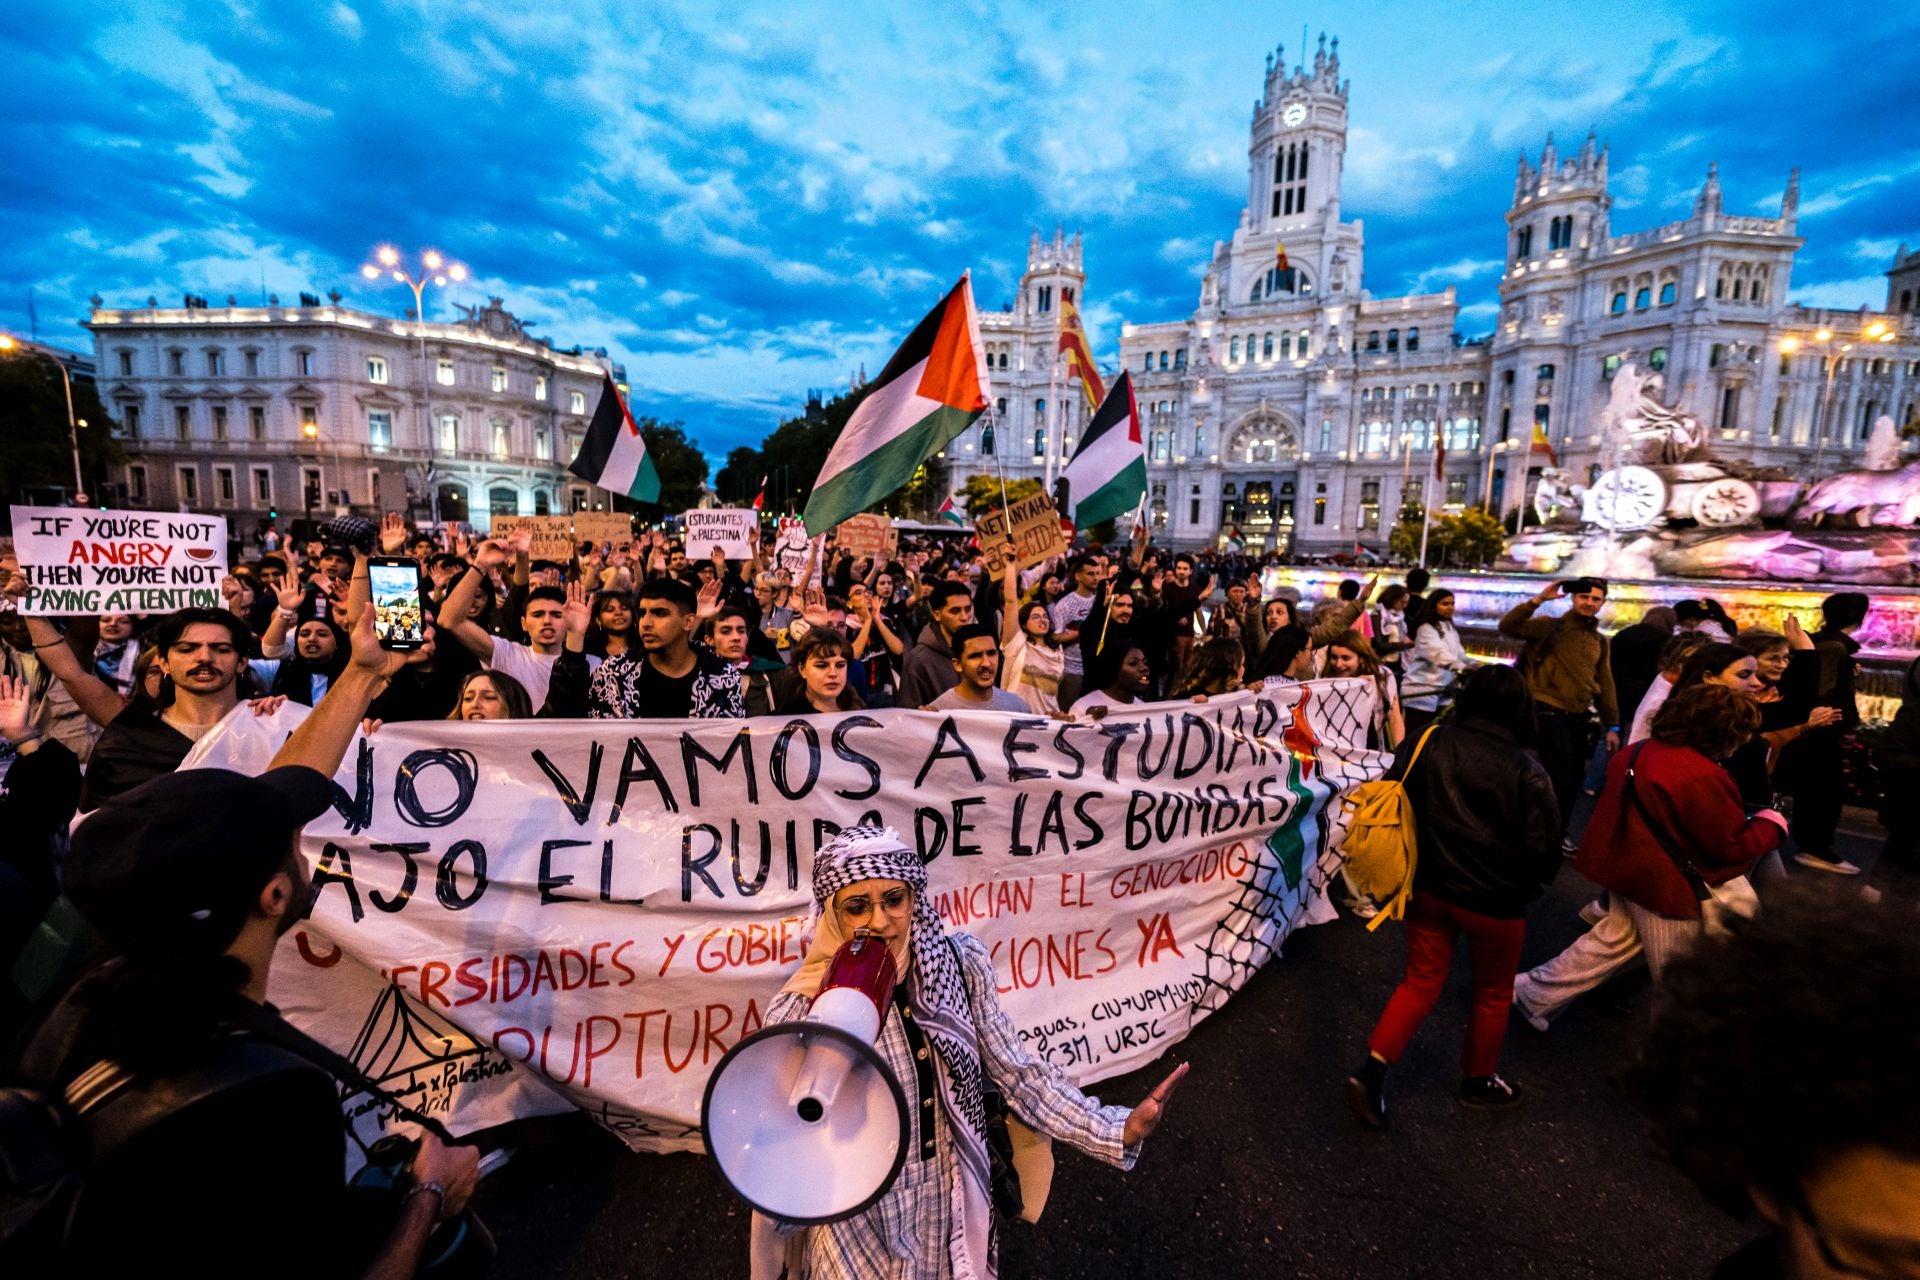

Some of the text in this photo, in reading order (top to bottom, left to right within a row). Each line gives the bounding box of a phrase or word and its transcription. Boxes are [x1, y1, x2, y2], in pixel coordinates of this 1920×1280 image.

[31, 515, 216, 542] IF YOU'RE NOT
[547, 522, 566, 532] SUR
[689, 514, 742, 526] ESTUDIANTES
[698, 529, 740, 541] PALESTINA
[68, 540, 173, 566] ANGRY
[20, 565, 222, 586] THEN YOU'RE NOT
[25, 587, 219, 611] PAYING ATTENTION
[531, 715, 884, 826] VAMOS
[914, 716, 987, 788] A
[1006, 698, 1283, 782] ESTUDIAR
[300, 839, 489, 922] AJO
[539, 838, 643, 906] EL
[914, 794, 984, 863] DE
[1008, 789, 1105, 856] LAS
[1124, 775, 1290, 850] BOMBAS
[657, 934, 686, 979] Y
[1060, 873, 1093, 908] EL
[1110, 842, 1248, 899] GENOCIDIO
[1138, 912, 1184, 968] YA
[1105, 1019, 1166, 1054] URJC
[443, 1053, 513, 1087] Palestina
